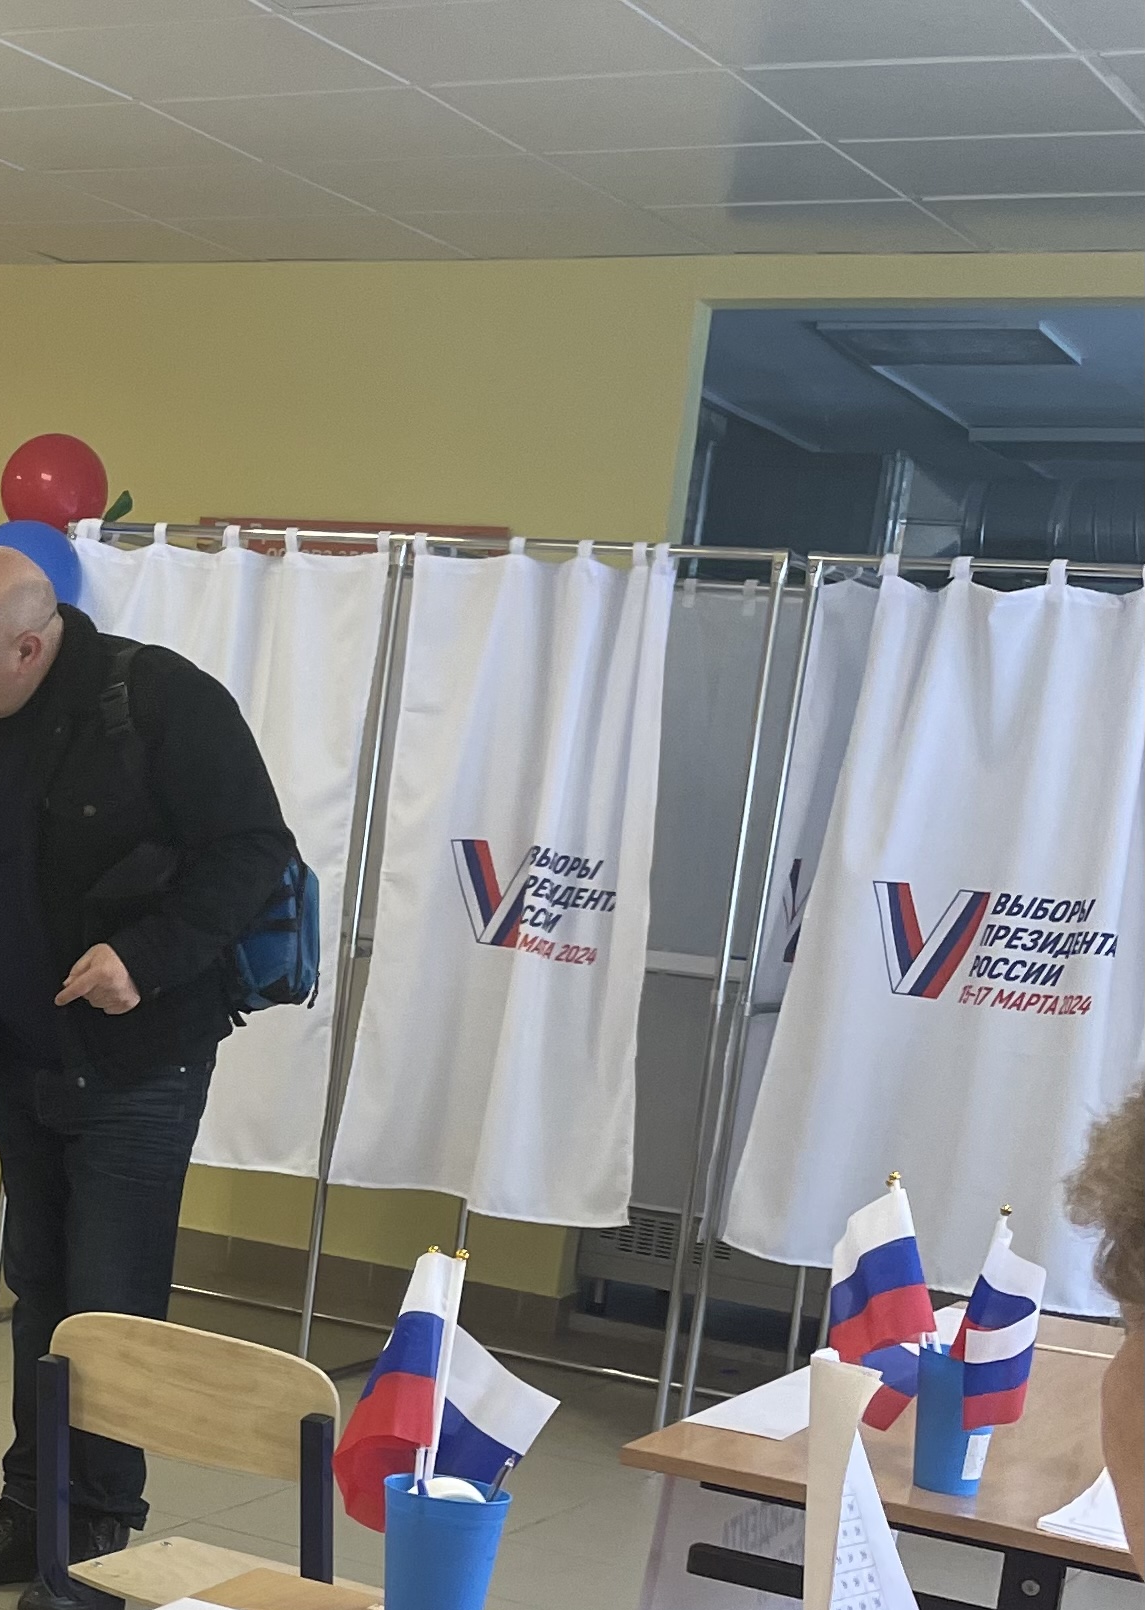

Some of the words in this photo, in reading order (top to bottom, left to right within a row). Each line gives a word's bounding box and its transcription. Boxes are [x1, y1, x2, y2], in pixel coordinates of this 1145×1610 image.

[991, 893, 1097, 923] ВЫБОРЫ
[554, 943, 598, 966] 2024
[979, 924, 1119, 960] ПРЕЗИДЕНТА
[968, 955, 1065, 987] РОССИИ
[989, 988, 1059, 1016] МАРТА
